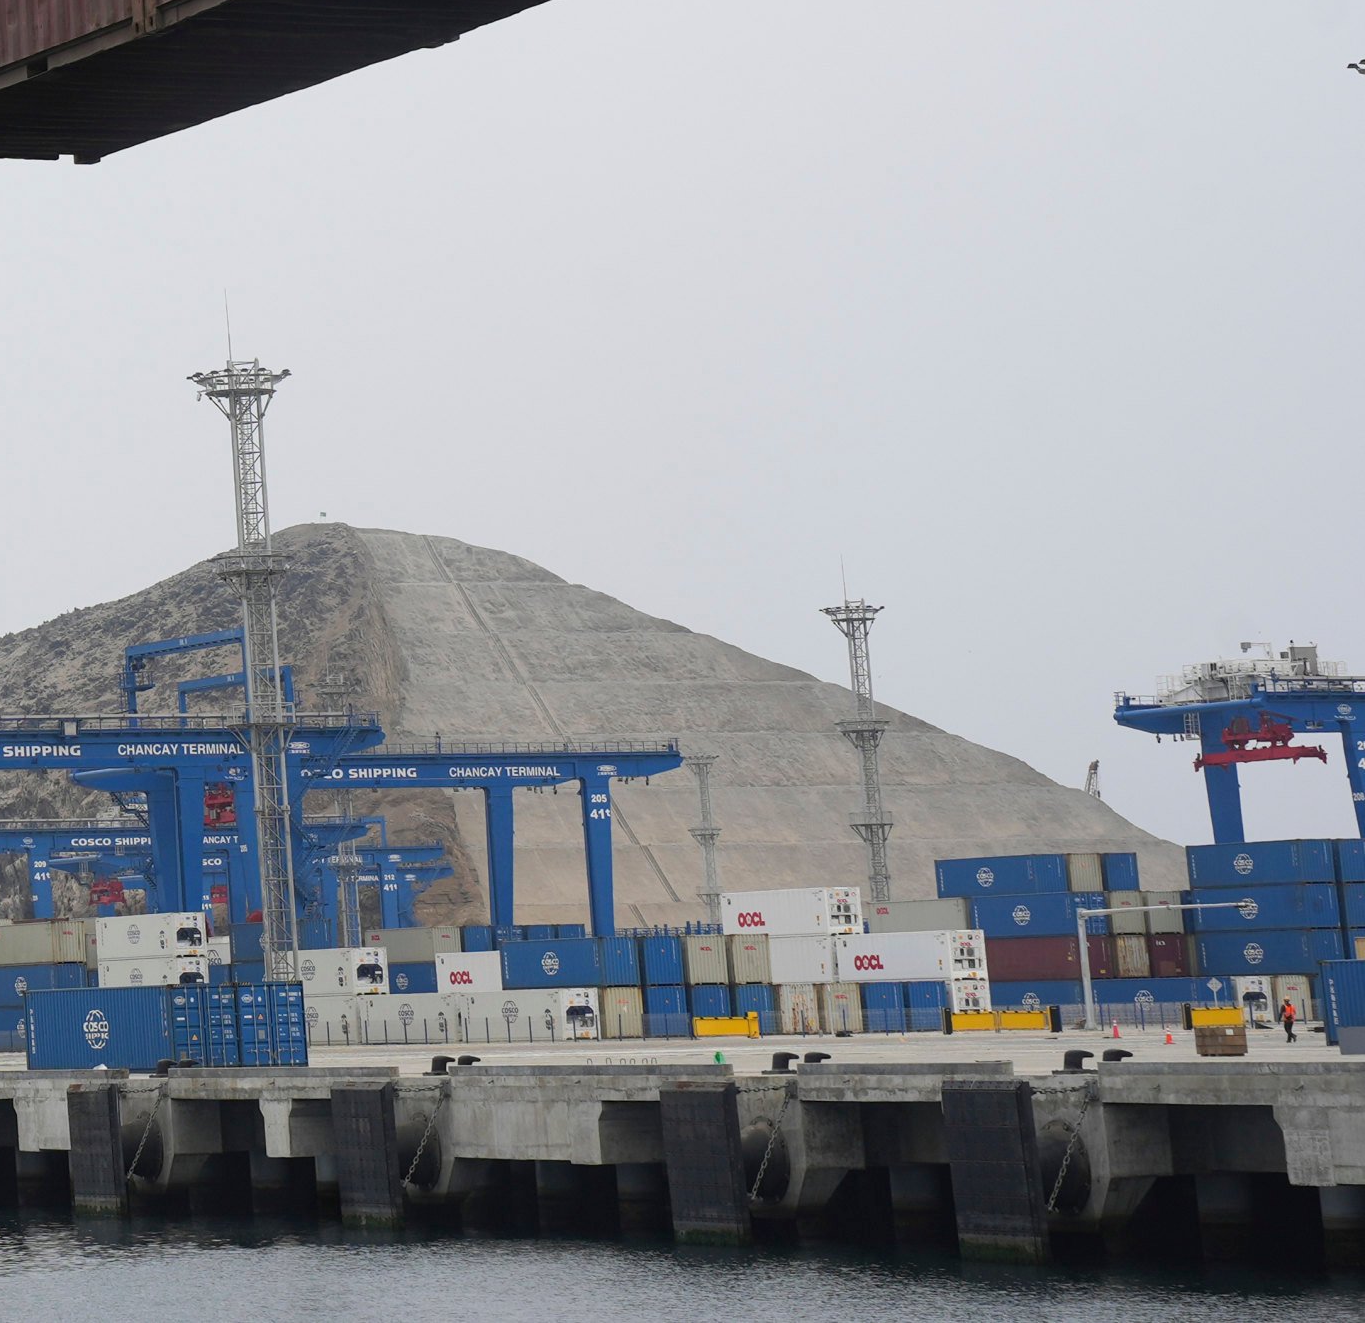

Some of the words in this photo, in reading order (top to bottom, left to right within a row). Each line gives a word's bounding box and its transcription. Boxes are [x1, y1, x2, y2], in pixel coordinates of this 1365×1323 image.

[3, 745, 81, 757] SHIPPING
[118, 744, 178, 755] CHANCAY
[182, 743, 244, 755] TERMINAL
[349, 768, 417, 778] SHIPPING
[449, 767, 502, 777] CHANCAY
[505, 767, 560, 776] TERMINAL
[591, 794, 607, 803] 205
[590, 809, 610, 819] 41t
[71, 838, 111, 846] COSCO
[115, 837, 151, 845] SHIPPI
[738, 912, 765, 927] OOCL
[541, 958, 559, 966] COSCO
[854, 955, 884, 971] OOCL
[450, 971, 473, 985] OOCL
[83, 1021, 109, 1032] COSCO
